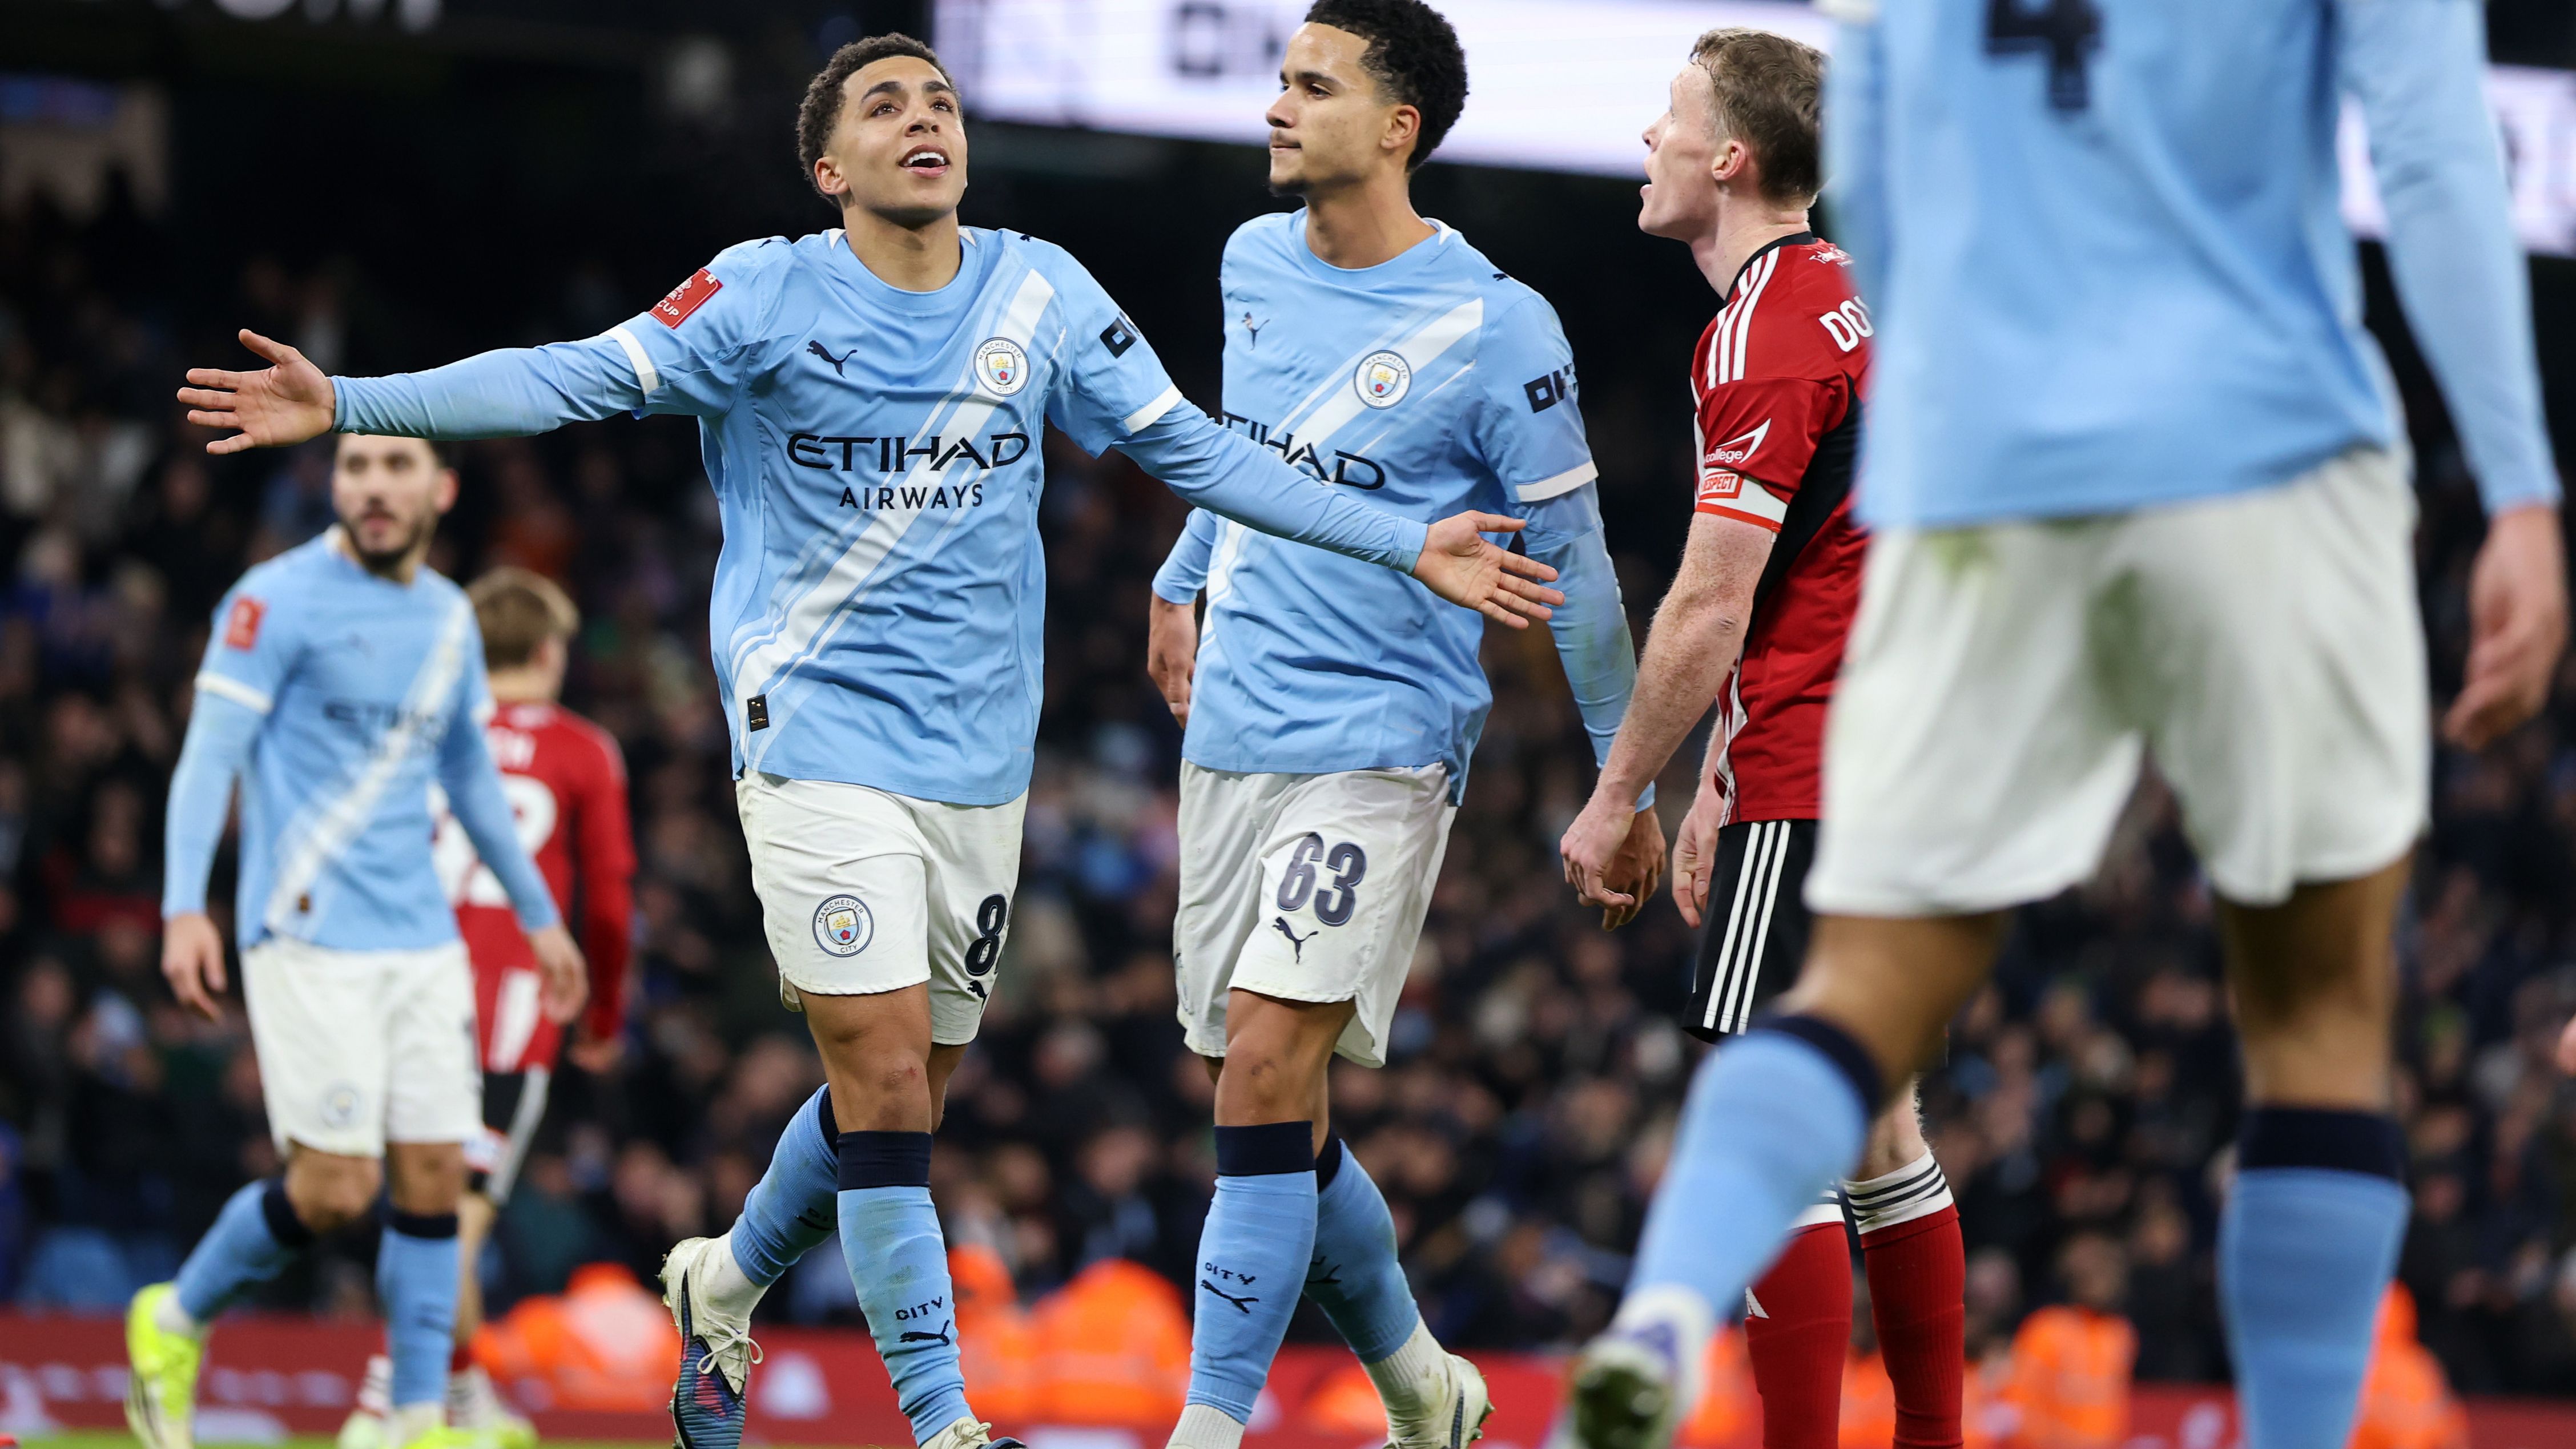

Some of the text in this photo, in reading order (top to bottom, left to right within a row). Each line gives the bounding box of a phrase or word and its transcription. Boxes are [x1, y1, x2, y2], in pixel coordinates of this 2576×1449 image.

[657, 300, 679, 316] CUP
[1819, 295, 1874, 352] DO
[978, 342, 1022, 360] MANCHESTER
[1365, 355, 1407, 379] MANCHESTER
[1367, 396, 1384, 405] CITY
[787, 433, 1030, 472] ETIHAD
[1224, 410, 1385, 490] TIHAD
[1705, 448, 1743, 464] college
[1702, 476, 1735, 492] ESPECT
[839, 484, 983, 510] AIRWAYS
[1277, 831, 1367, 927] 63
[818, 900, 864, 923] MANCHESTER
[964, 893, 1014, 976] 8
[840, 944, 857, 953] CITY
[1205, 1262, 1256, 1285] CITY
[895, 1296, 943, 1320] CITY
